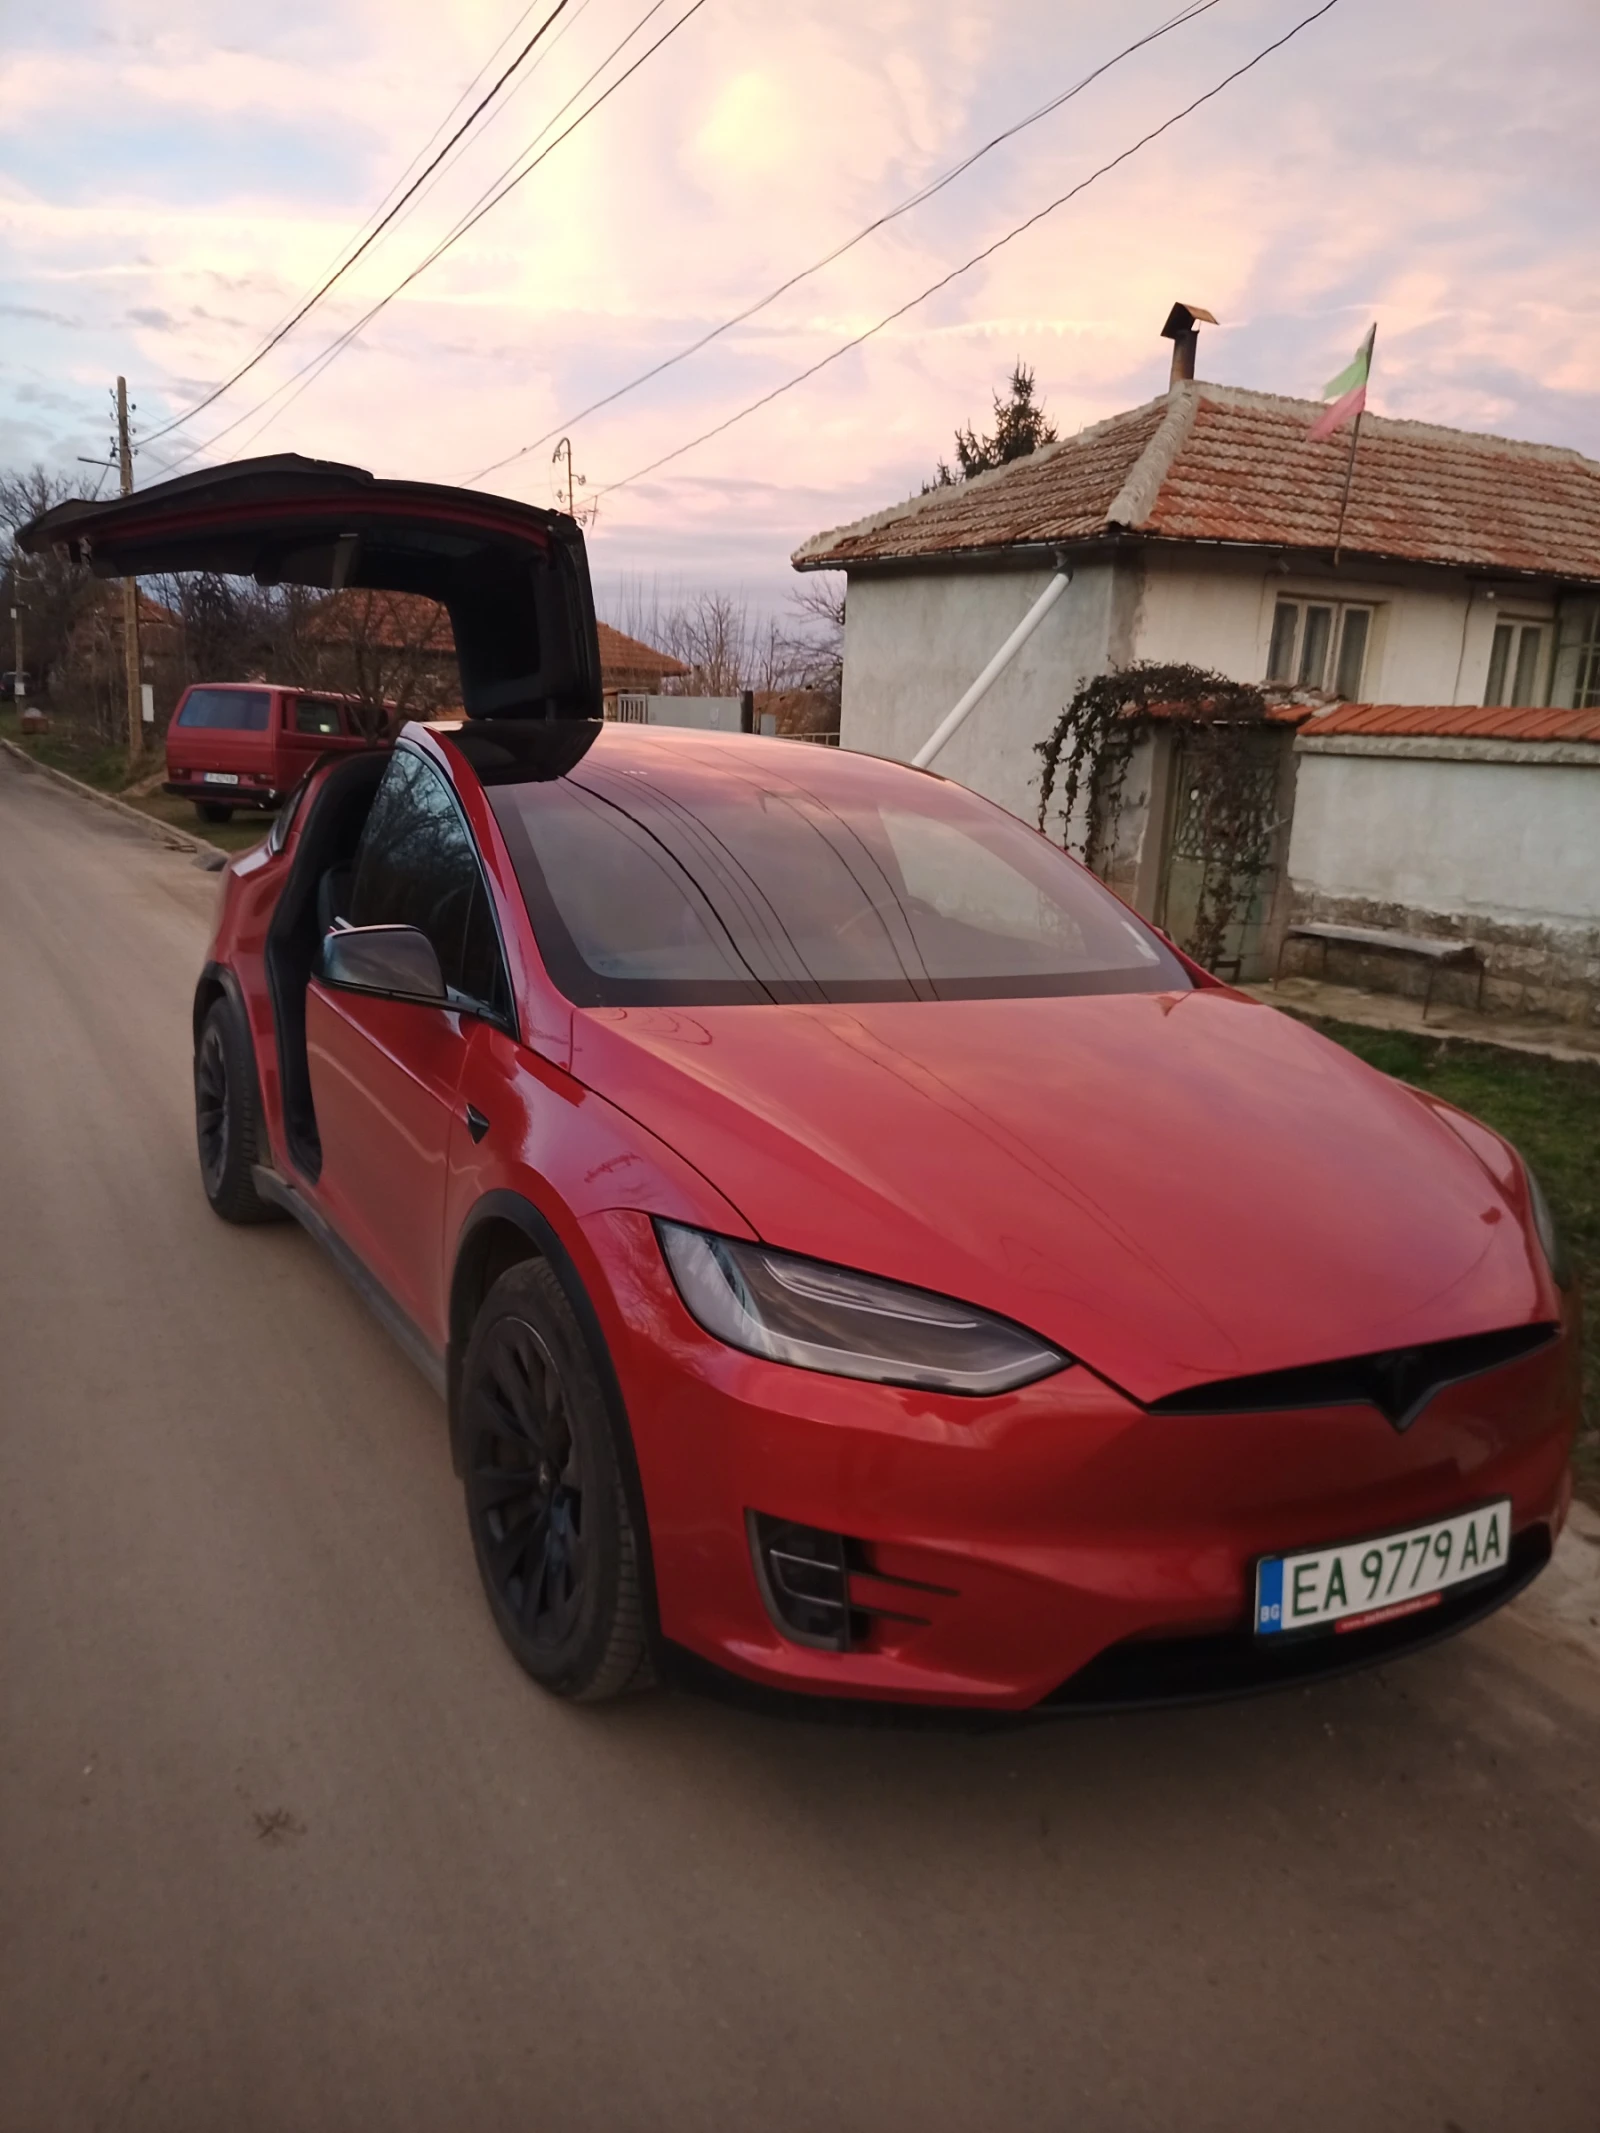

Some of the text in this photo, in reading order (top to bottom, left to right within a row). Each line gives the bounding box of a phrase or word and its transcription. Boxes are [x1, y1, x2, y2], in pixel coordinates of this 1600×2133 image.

[1293, 1557, 1347, 1617] EA
[1360, 1530, 1452, 1601] 9779
[1459, 1513, 1500, 1571] AA
[1260, 1604, 1280, 1622] BG
